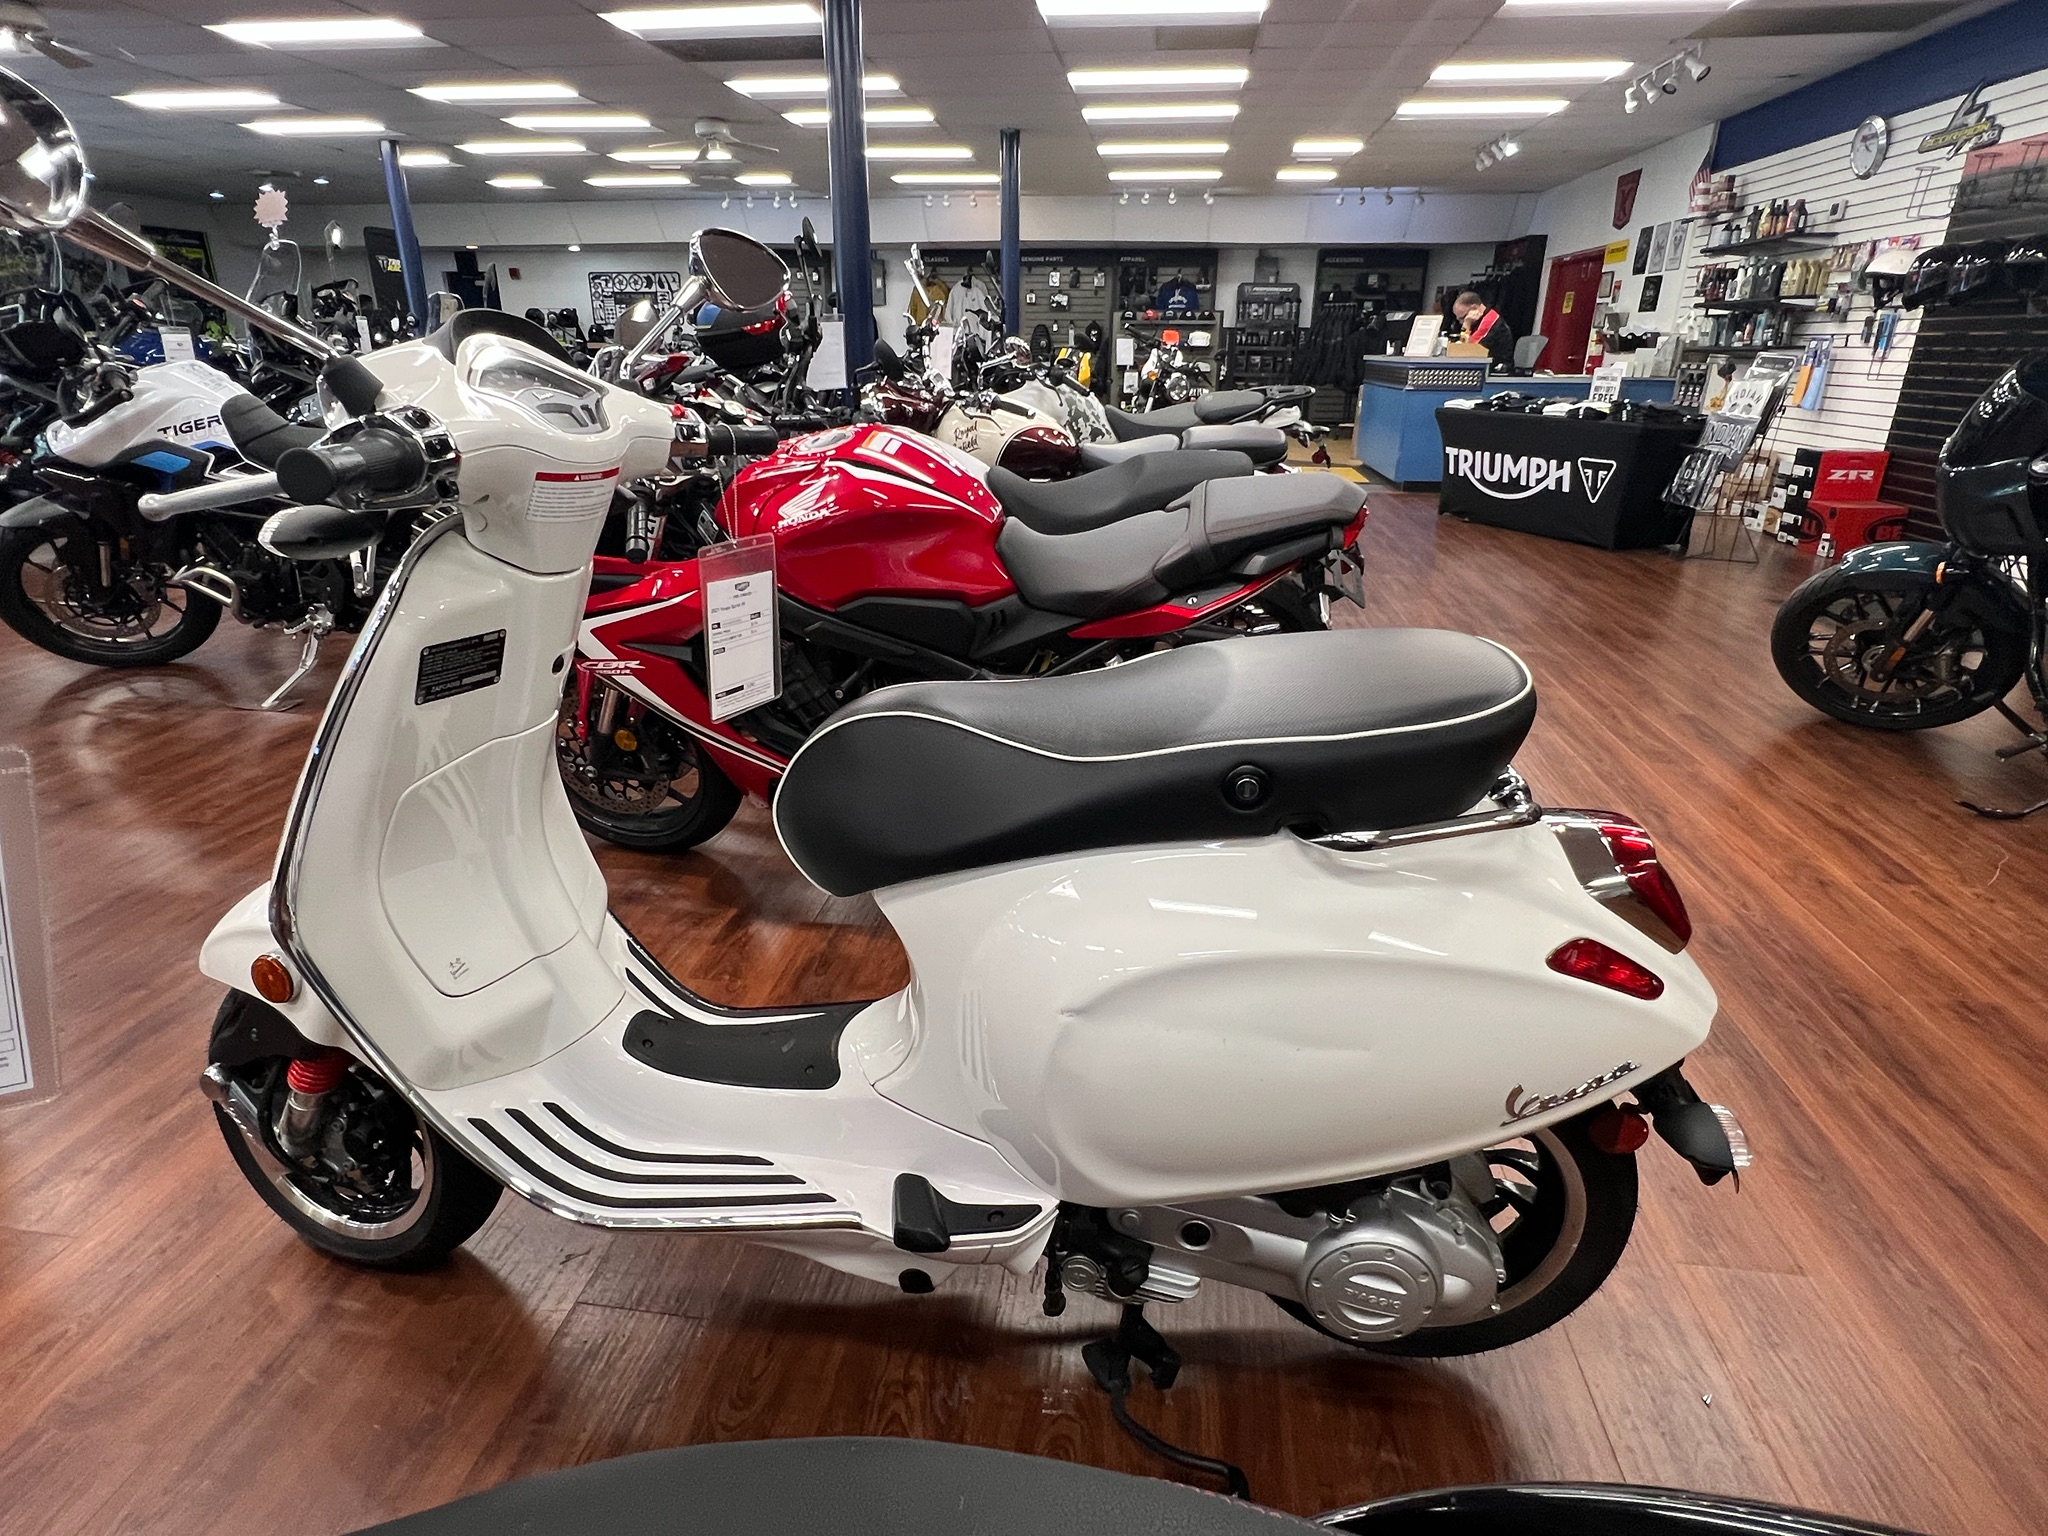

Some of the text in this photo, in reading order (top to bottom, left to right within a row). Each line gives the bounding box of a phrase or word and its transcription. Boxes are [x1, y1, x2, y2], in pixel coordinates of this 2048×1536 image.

[1922, 121, 1992, 148] SCORPION
[1593, 393, 1614, 402] FREE
[157, 414, 222, 436] TIGER
[953, 420, 977, 442] Royal
[1445, 446, 1571, 499] TRIUMPH
[777, 508, 830, 529] HONDA
[581, 660, 646, 669] CBR
[1344, 1286, 1402, 1310] PIAGGIO
